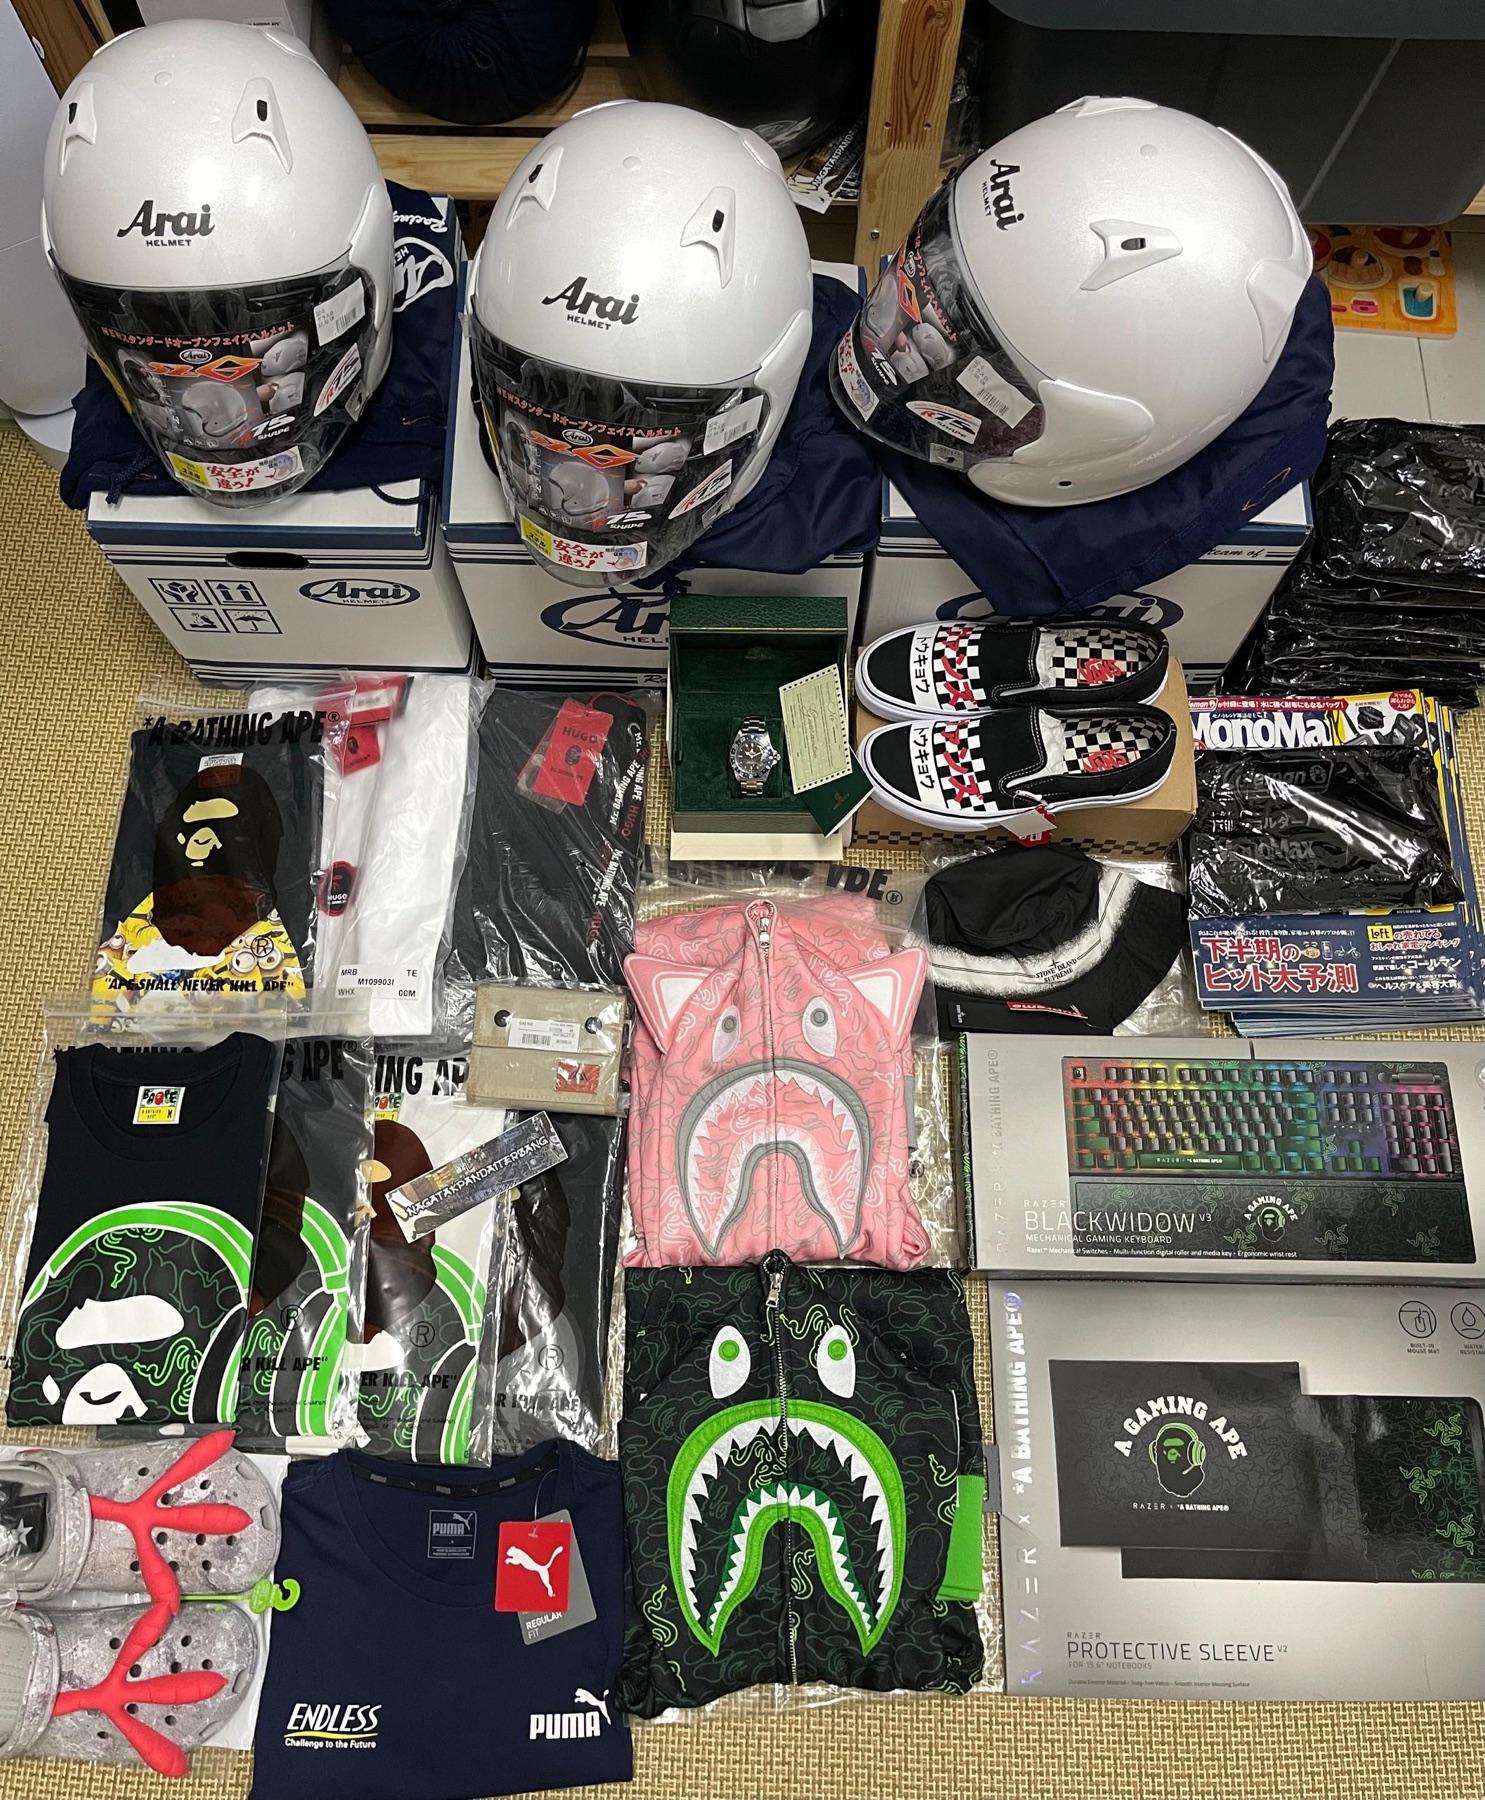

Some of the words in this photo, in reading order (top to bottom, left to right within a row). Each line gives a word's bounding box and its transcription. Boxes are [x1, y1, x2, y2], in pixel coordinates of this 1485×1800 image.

[982, 181, 991, 216] HELMET
[990, 159, 1024, 231] Arai
[117, 200, 215, 237] Arai
[146, 239, 192, 247] HELMET
[541, 276, 640, 325] Arai
[566, 314, 612, 331] HELMET
[257, 427, 290, 440] SHAPE
[207, 466, 260, 478] 安全が
[553, 539, 604, 559] 安全が
[310, 581, 407, 598] Arai
[913, 637, 931, 693] トウキョウ
[562, 726, 598, 744] HUGO
[914, 727, 936, 789] トウキョウ
[626, 759, 641, 778] APE
[632, 785, 643, 801] APE
[620, 804, 640, 840] HUGO
[1371, 929, 1390, 939] Loft
[1393, 928, 1442, 940] の売れてる
[1201, 936, 1301, 964] 下半期の
[341, 969, 358, 977] MRB
[406, 969, 418, 977] TE
[1035, 968, 1056, 979] STONE
[1056, 958, 1078, 971] ISLAND
[1043, 967, 1074, 983] SUPREME
[137, 978, 179, 991] SHALL
[182, 979, 225, 992] NEVER
[229, 980, 258, 992] KILL
[1203, 963, 1359, 993] ヒット大予測
[338, 988, 355, 996] WHX
[1024, 1199, 1066, 1208] RAZER
[1248, 1195, 1282, 1212] GAMING
[1282, 1204, 1299, 1221] APE
[1024, 1211, 1195, 1233] BLACKWIDOW
[1199, 1213, 1212, 1221] V3
[1025, 1234, 1083, 1243] MECHANICAL
[1086, 1235, 1122, 1243] GAMING
[1124, 1235, 1172, 1243] KEYBOARD
[1113, 1248, 1155, 1256] Multi-function
[1155, 1249, 1174, 1257] digital
[1237, 1250, 1269, 1258] Ergonomic
[1008, 1360, 1032, 1461] BATHING
[1113, 1440, 1133, 1457] A
[1123, 1395, 1208, 1436] GAMING
[1208, 1416, 1248, 1460] APE
[1132, 1502, 1166, 1510] RAZER
[432, 1522, 465, 1535] PUMA
[525, 1611, 562, 1630] REGULAR
[527, 1628, 540, 1640] FIT
[1067, 1631, 1101, 1640] RAZER
[1067, 1641, 1191, 1661] PROTECTIVE
[1199, 1643, 1275, 1662] SLEEVE
[1277, 1645, 1288, 1653] V2
[1068, 1661, 1084, 1669] FOR
[1106, 1662, 1152, 1670] NOTEBOOKS
[286, 1703, 382, 1731] ENDLESS
[529, 1710, 601, 1739] PUMA
[284, 1738, 324, 1750] Challenge
[325, 1740, 334, 1748] to
[335, 1740, 348, 1749] the
[349, 1740, 377, 1749] Future
